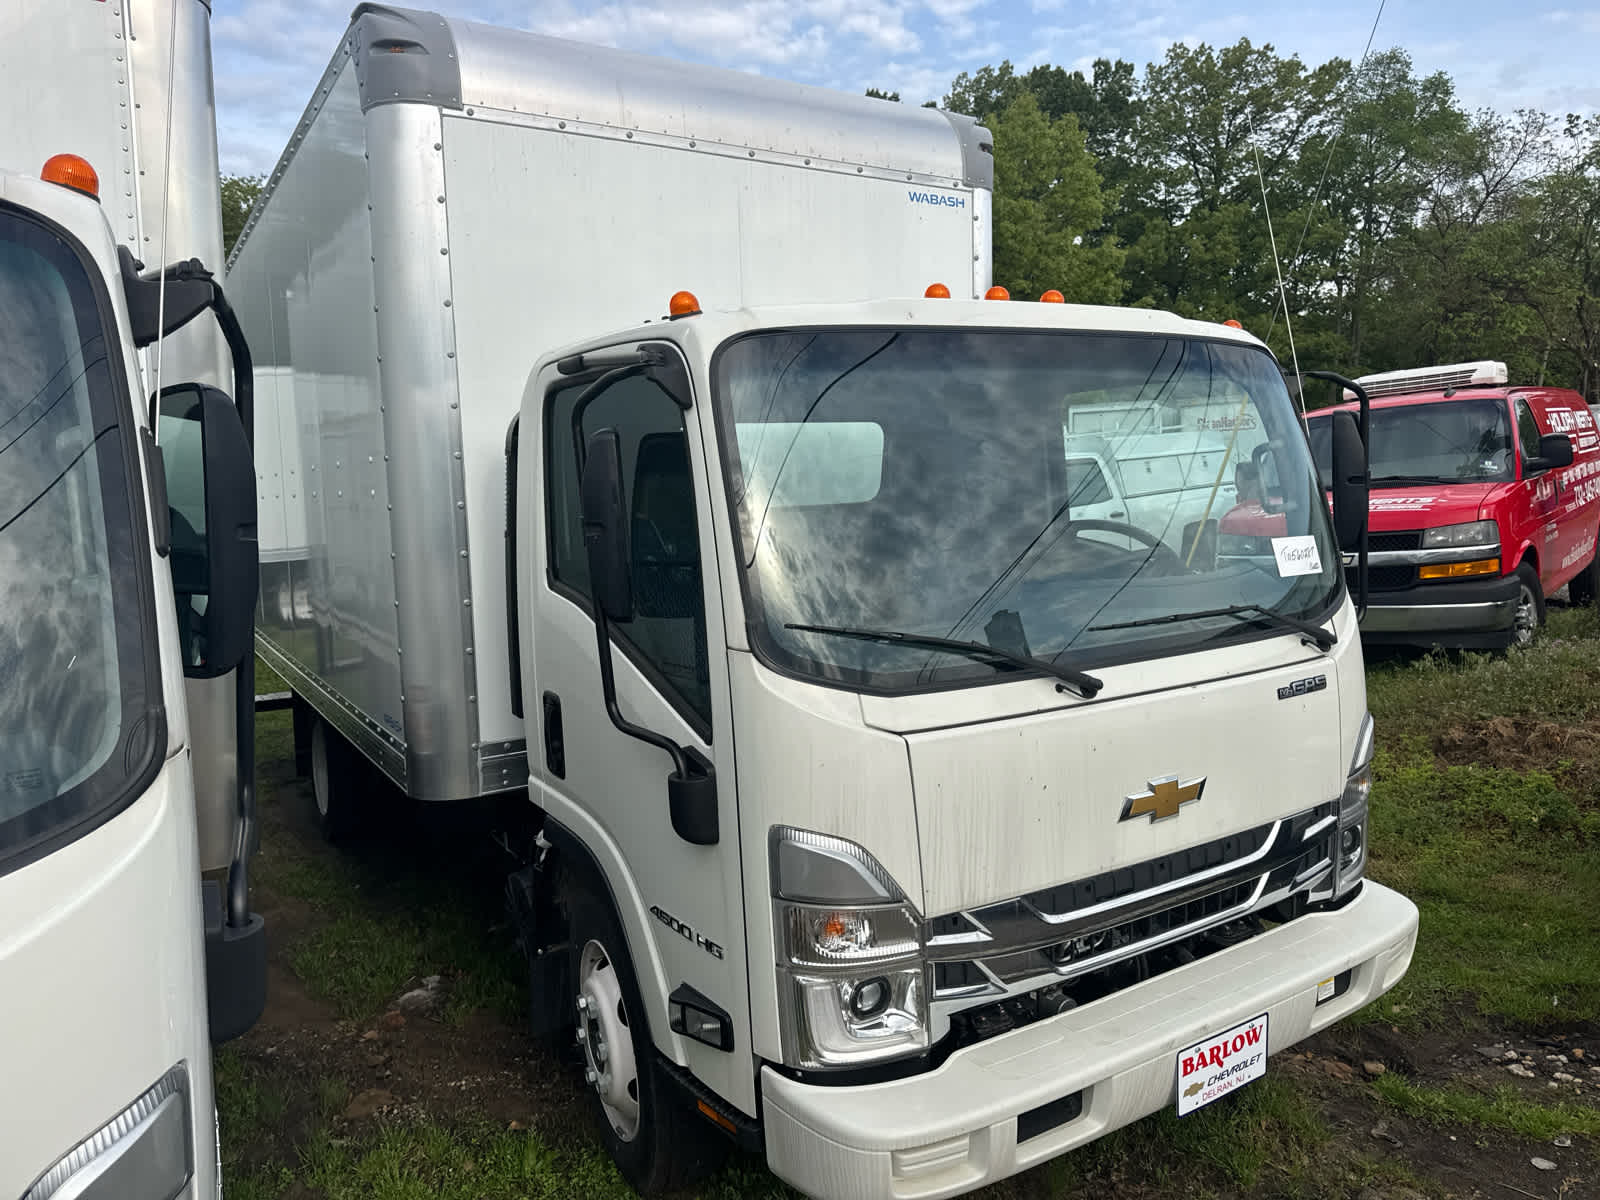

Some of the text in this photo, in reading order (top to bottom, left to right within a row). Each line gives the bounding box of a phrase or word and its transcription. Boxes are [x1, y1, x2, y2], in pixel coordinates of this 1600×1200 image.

[908, 191, 965, 208] WABASH
[649, 905, 724, 961] 4500 HG
[1182, 1024, 1263, 1077] BARLOW
[1207, 1052, 1263, 1087] CHEVROLET
[1236, 1073, 1245, 1084] NJ
